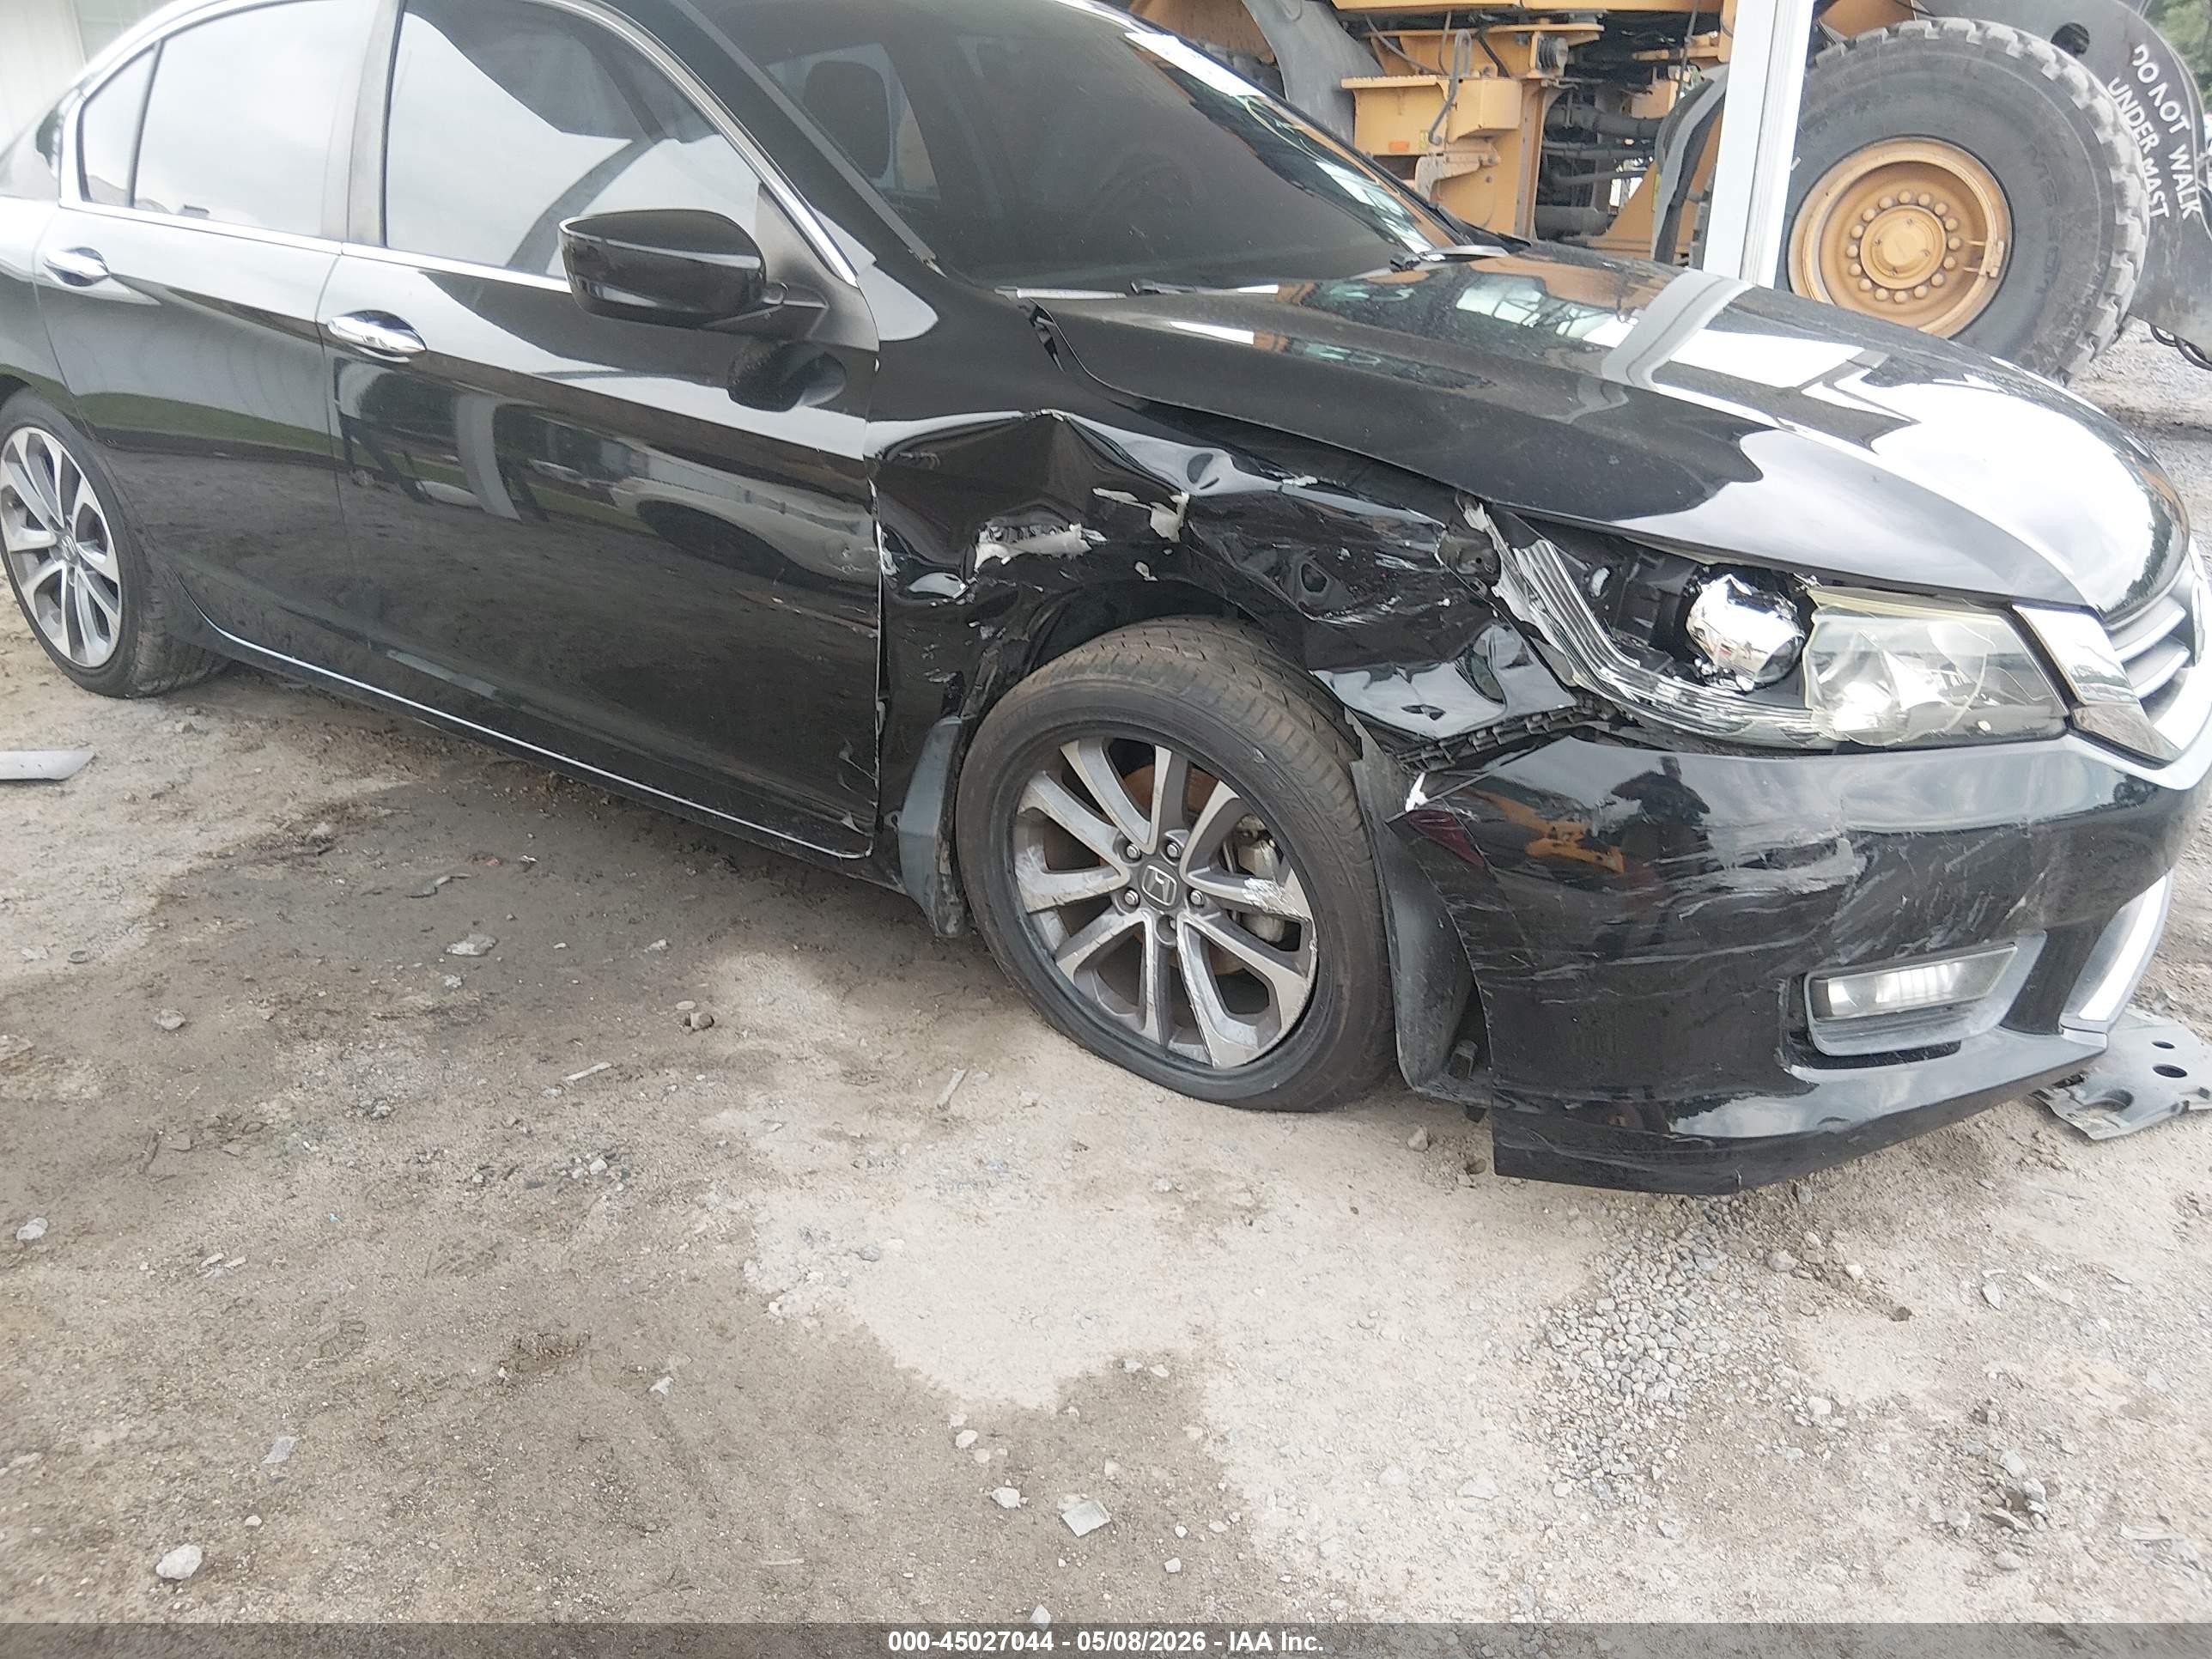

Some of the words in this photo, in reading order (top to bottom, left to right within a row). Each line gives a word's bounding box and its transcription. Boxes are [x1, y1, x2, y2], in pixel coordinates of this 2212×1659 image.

[2107, 76, 2160, 154] UNDER
[2142, 156, 2169, 218] MAST
[2168, 143, 2203, 220] WALK
